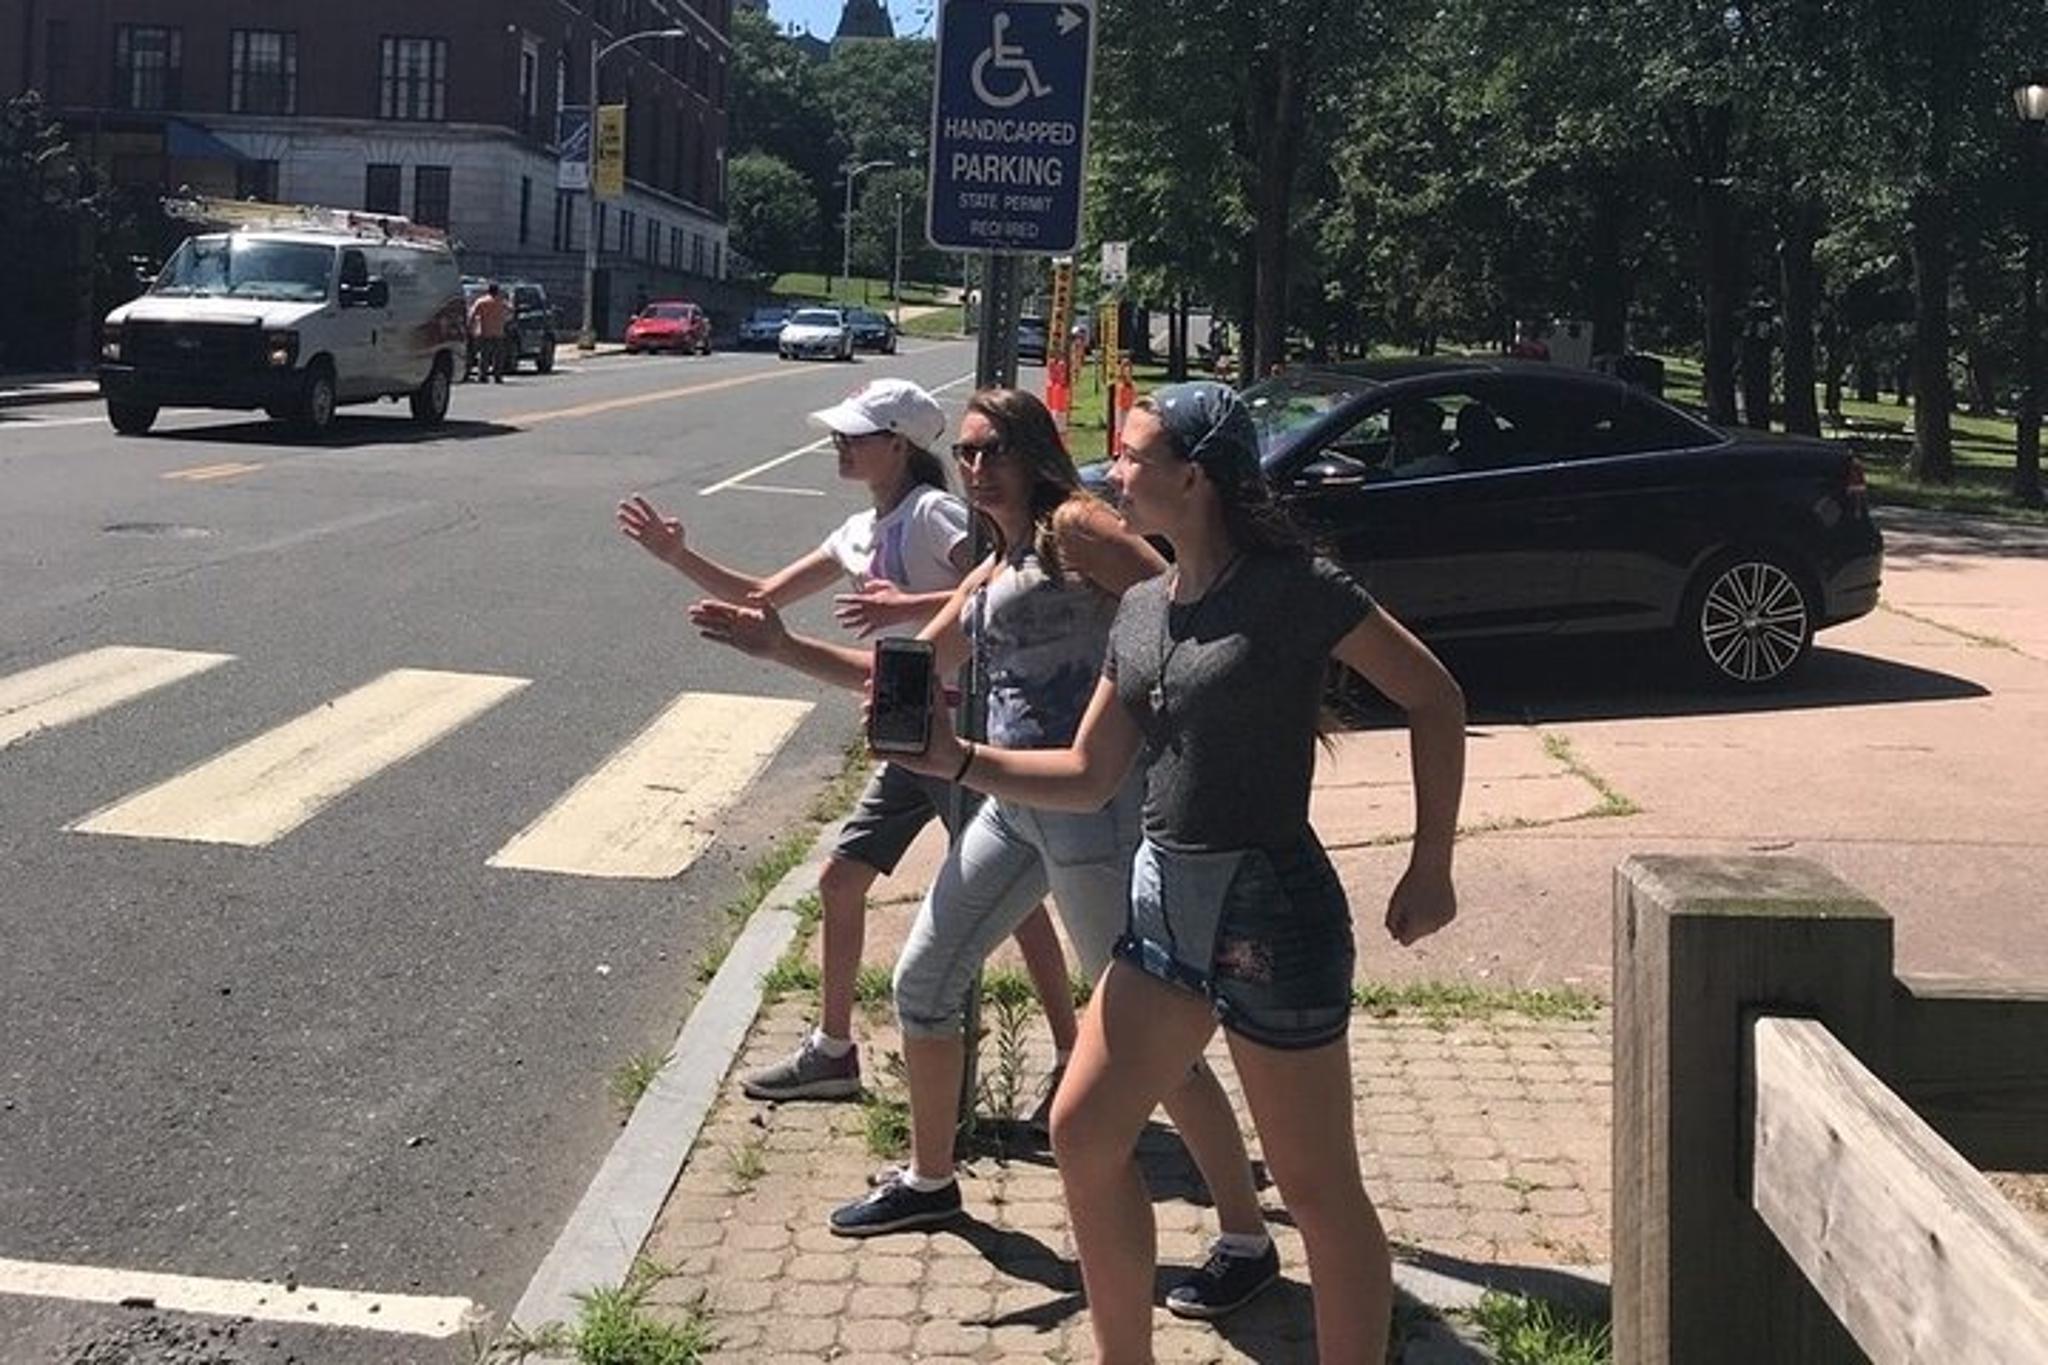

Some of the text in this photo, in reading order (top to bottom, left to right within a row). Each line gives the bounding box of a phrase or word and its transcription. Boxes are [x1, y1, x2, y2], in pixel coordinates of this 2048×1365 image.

[944, 117, 1076, 146] HANDICAPPED
[952, 153, 1063, 186] PARKING
[958, 192, 1054, 213] STATE PERMIT
